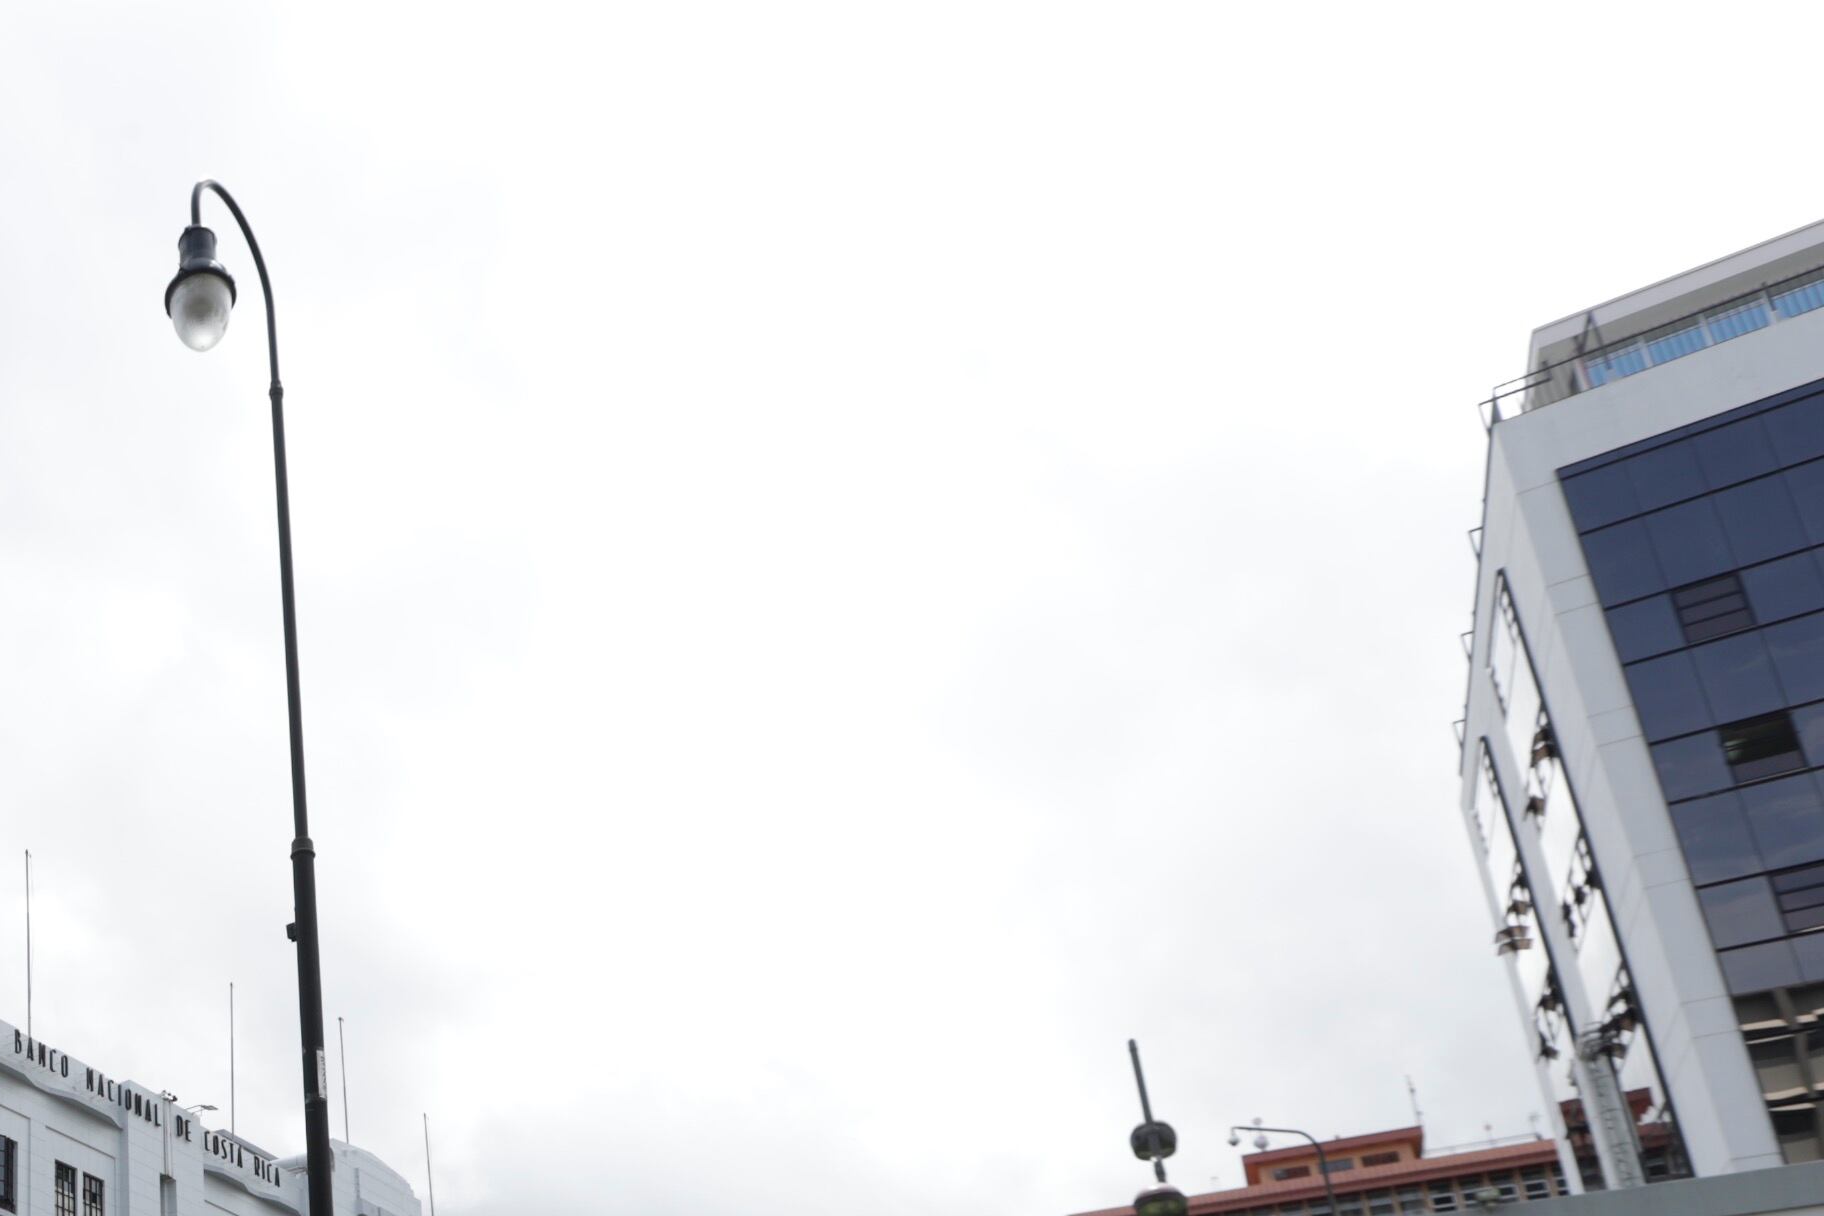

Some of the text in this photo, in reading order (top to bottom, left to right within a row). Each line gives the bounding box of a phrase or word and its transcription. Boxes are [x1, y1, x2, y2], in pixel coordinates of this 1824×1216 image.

[14, 1028, 281, 1188] BANCO NACIONAL DE COSTA RICA
